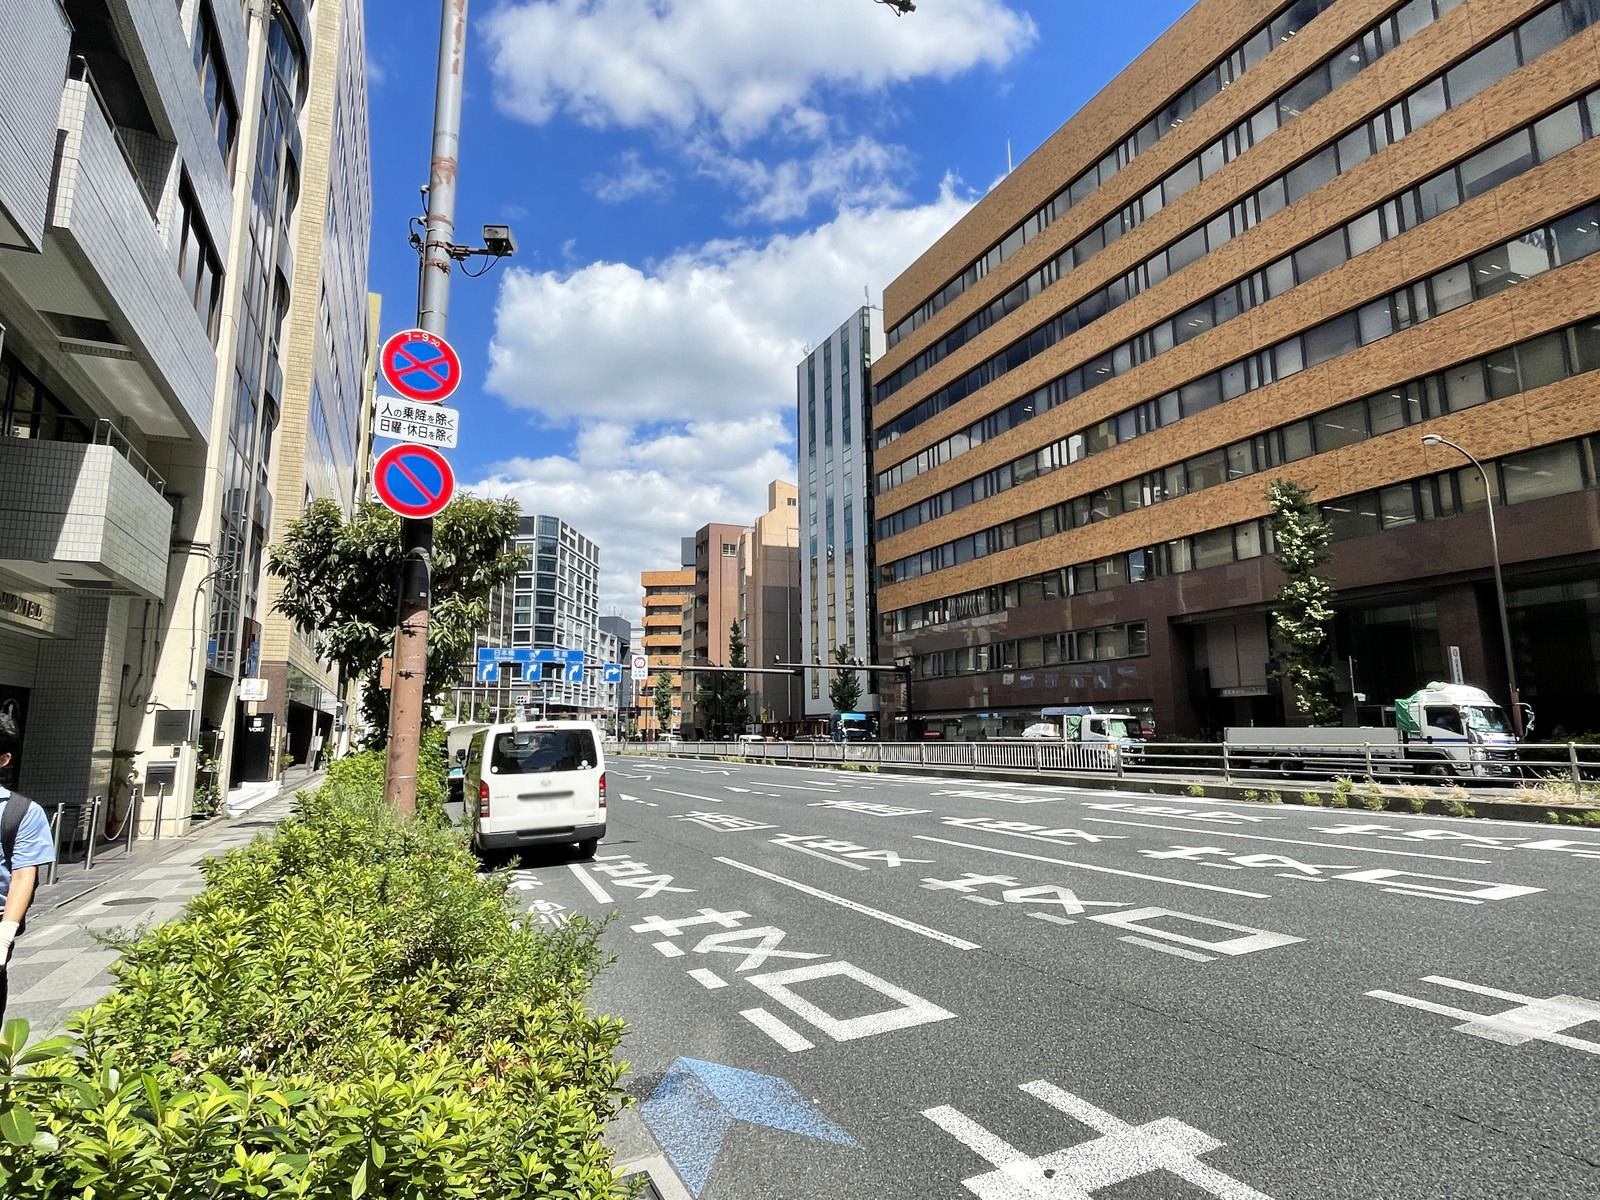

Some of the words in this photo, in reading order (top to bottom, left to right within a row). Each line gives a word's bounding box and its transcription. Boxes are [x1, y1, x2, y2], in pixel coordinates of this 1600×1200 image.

[381, 403, 454, 427] 人の乗降を除く
[380, 419, 453, 443] 日曜・休日を除く
